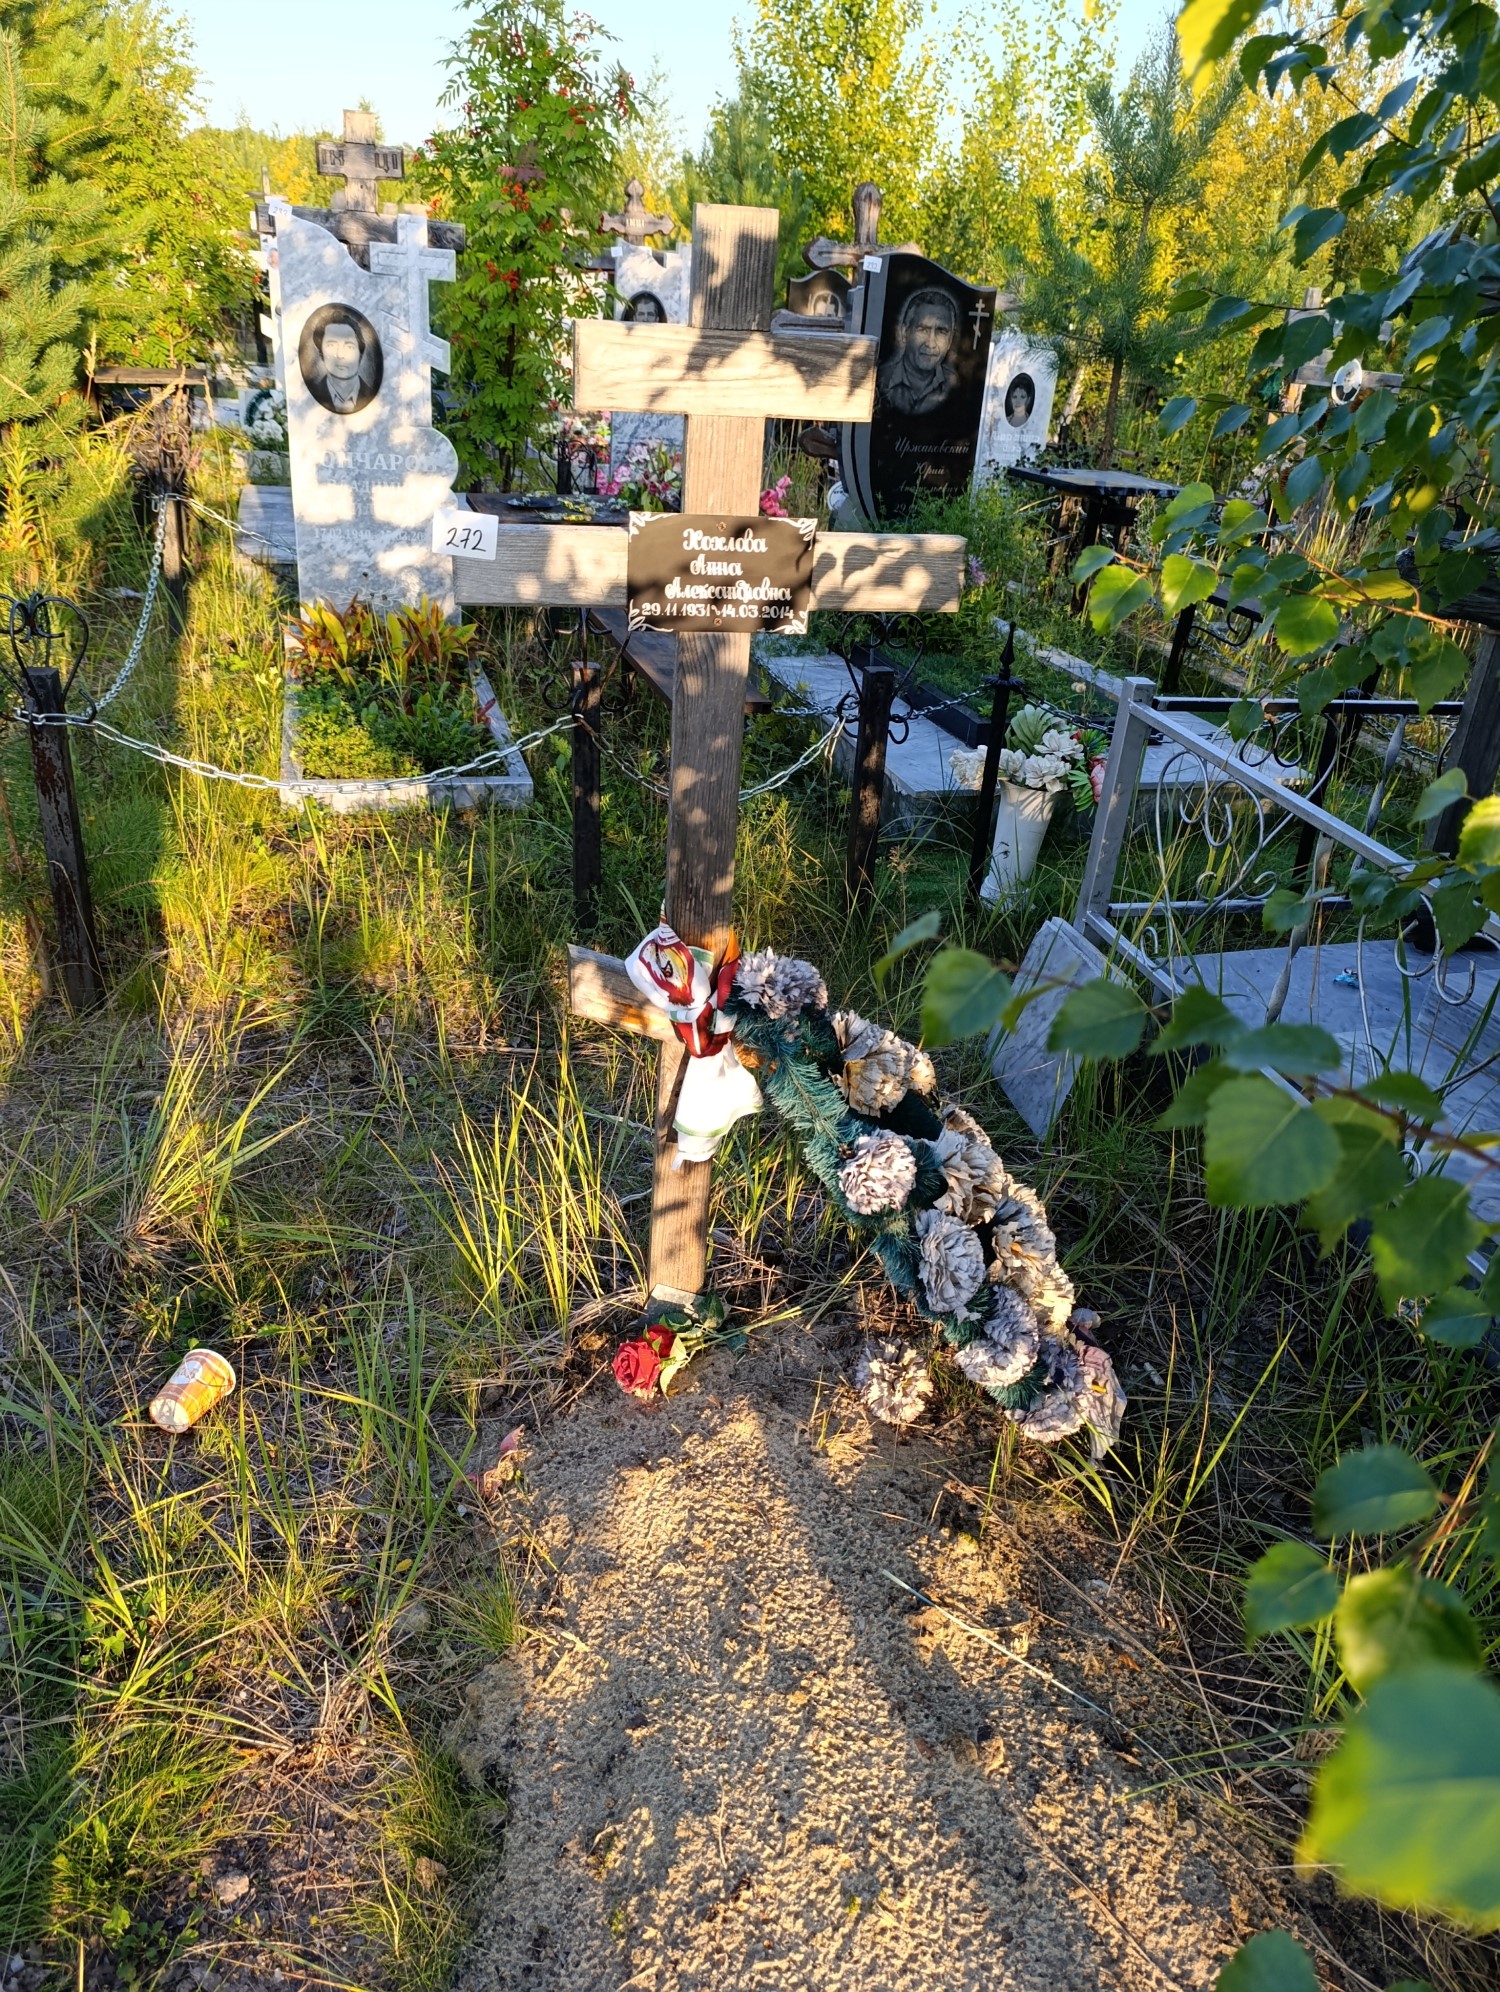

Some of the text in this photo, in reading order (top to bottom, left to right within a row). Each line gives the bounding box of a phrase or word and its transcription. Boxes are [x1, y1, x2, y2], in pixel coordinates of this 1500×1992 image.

[319, 450, 437, 472] ОНЧАРОВ
[913, 460, 945, 480] Юрий
[445, 527, 486, 552] 272
[683, 527, 768, 552] Хохлова
[690, 553, 743, 576] Анна
[664, 576, 793, 603] Александровна
